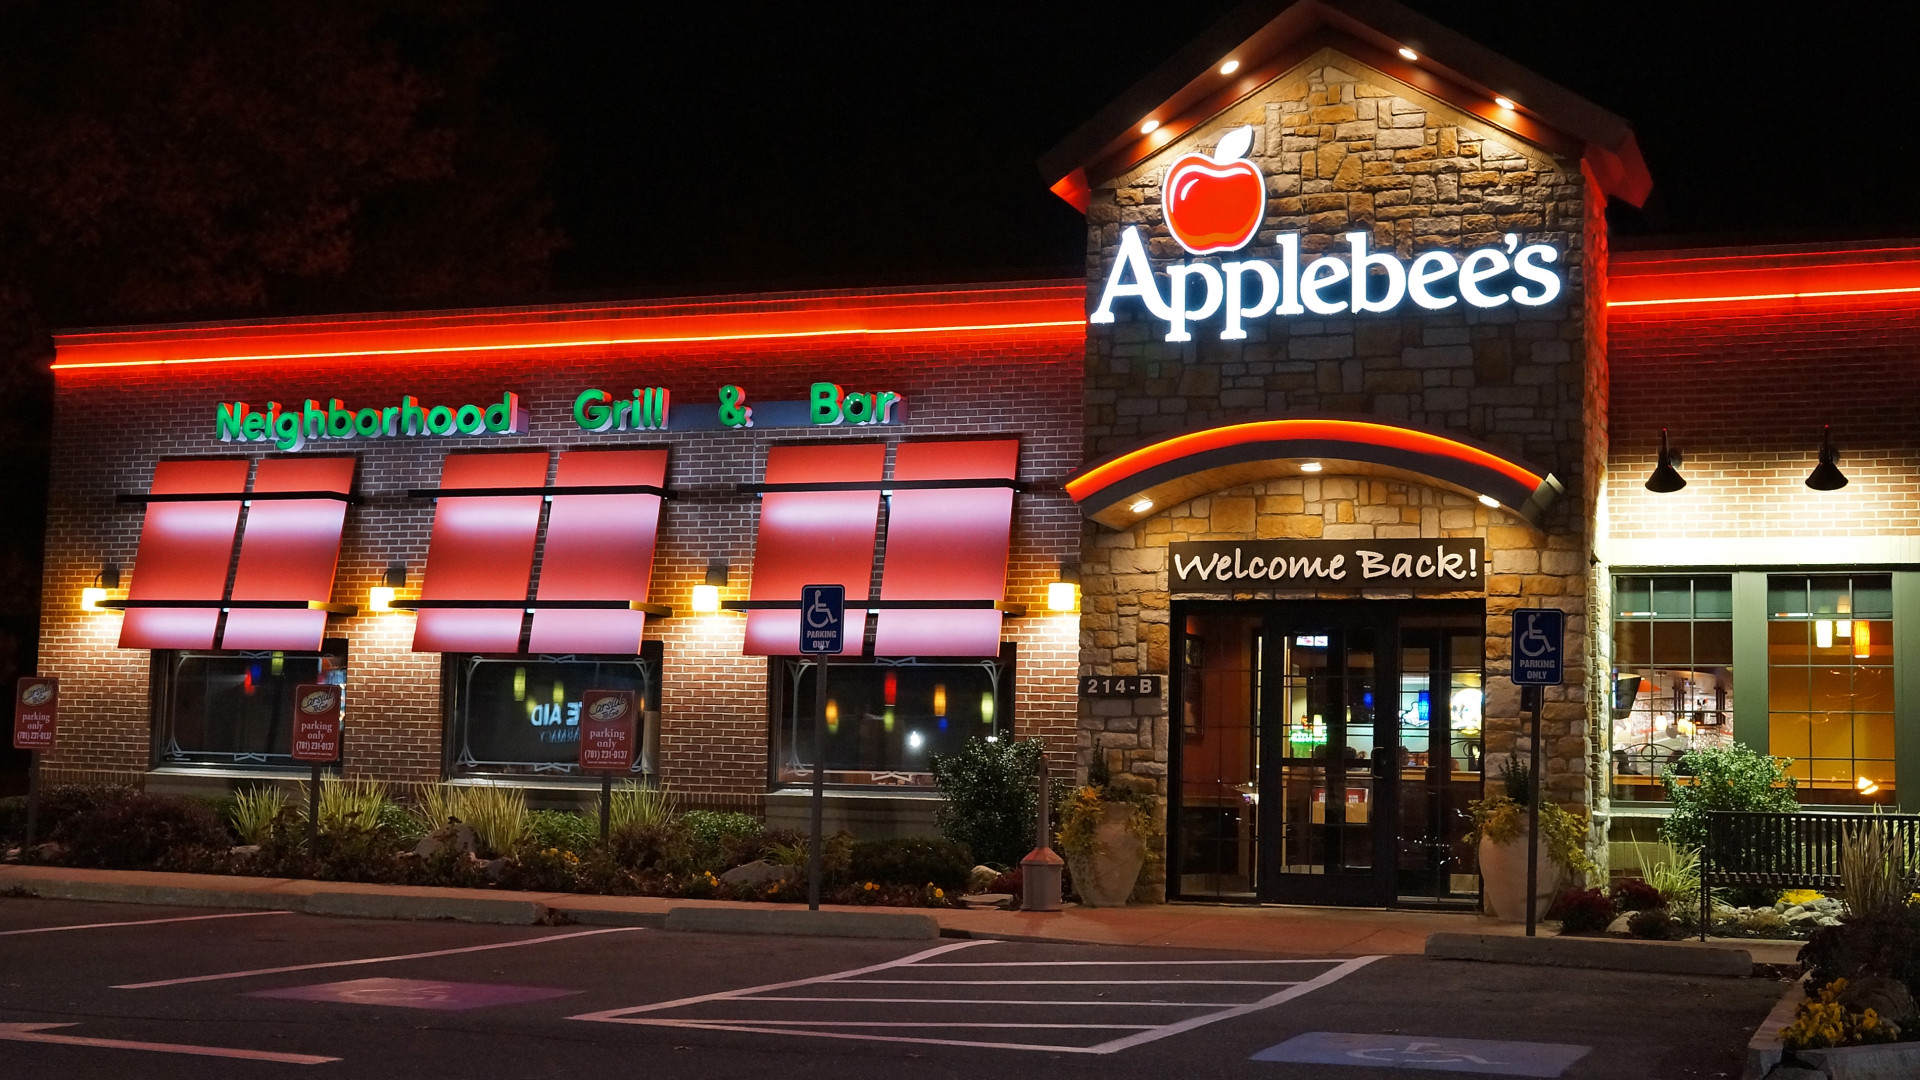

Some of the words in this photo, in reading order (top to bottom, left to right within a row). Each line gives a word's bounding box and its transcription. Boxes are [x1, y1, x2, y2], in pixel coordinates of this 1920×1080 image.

[1090, 224, 1562, 342] Applebee's
[215, 390, 516, 451] Neighborhood
[573, 386, 668, 430] Grill
[719, 384, 752, 428] &
[810, 382, 901, 425] Bar
[1174, 547, 1347, 581] Welcome
[1355, 545, 1478, 580] Back!
[806, 630, 837, 638] PARKING
[812, 640, 831, 649] ONLY
[1520, 660, 1555, 668] PARKING
[1526, 670, 1548, 680] ONLY
[1087, 679, 1152, 694] 214-B
[22, 712, 50, 723] parking
[27, 721, 44, 732] only
[301, 720, 332, 734] parking
[308, 730, 325, 742] only
[590, 728, 625, 740] parking
[596, 738, 617, 750] only
[602, 750, 628, 760] 231-0137
